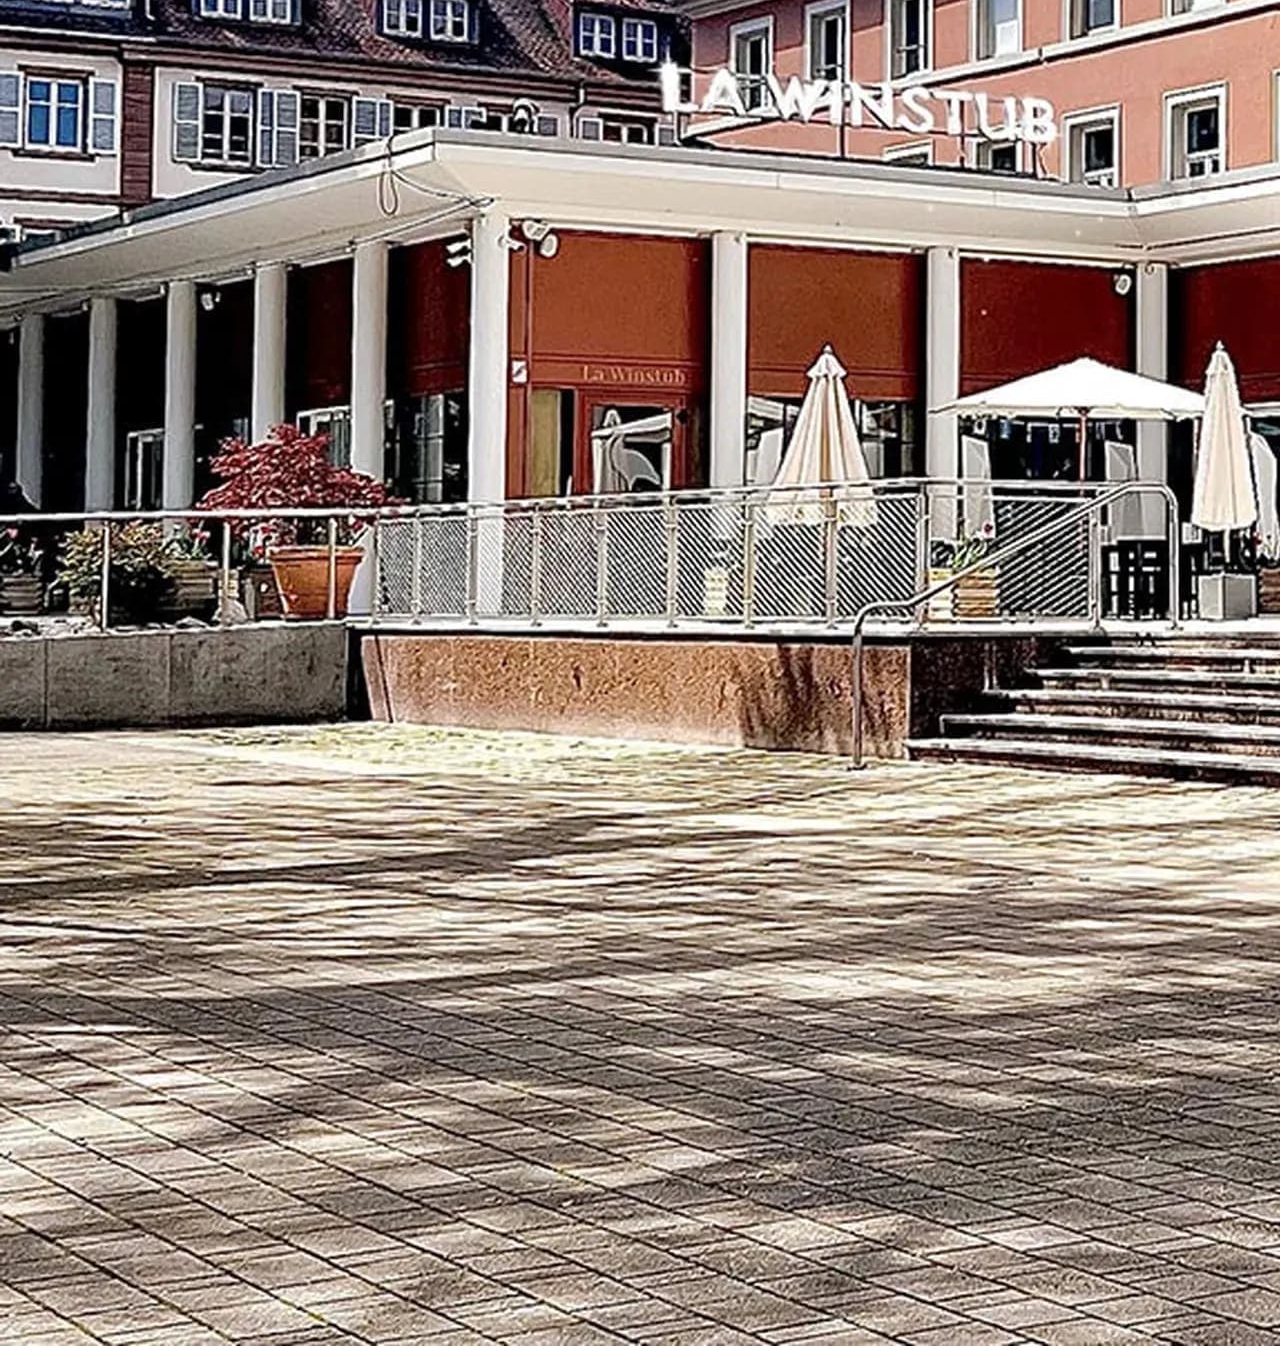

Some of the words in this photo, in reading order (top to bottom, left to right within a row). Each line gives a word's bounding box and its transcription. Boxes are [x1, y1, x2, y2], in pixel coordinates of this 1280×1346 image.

[660, 63, 746, 114] LA
[764, 72, 1059, 143] WINSTUB
[582, 365, 605, 381] La
[608, 365, 687, 384] Winstub
